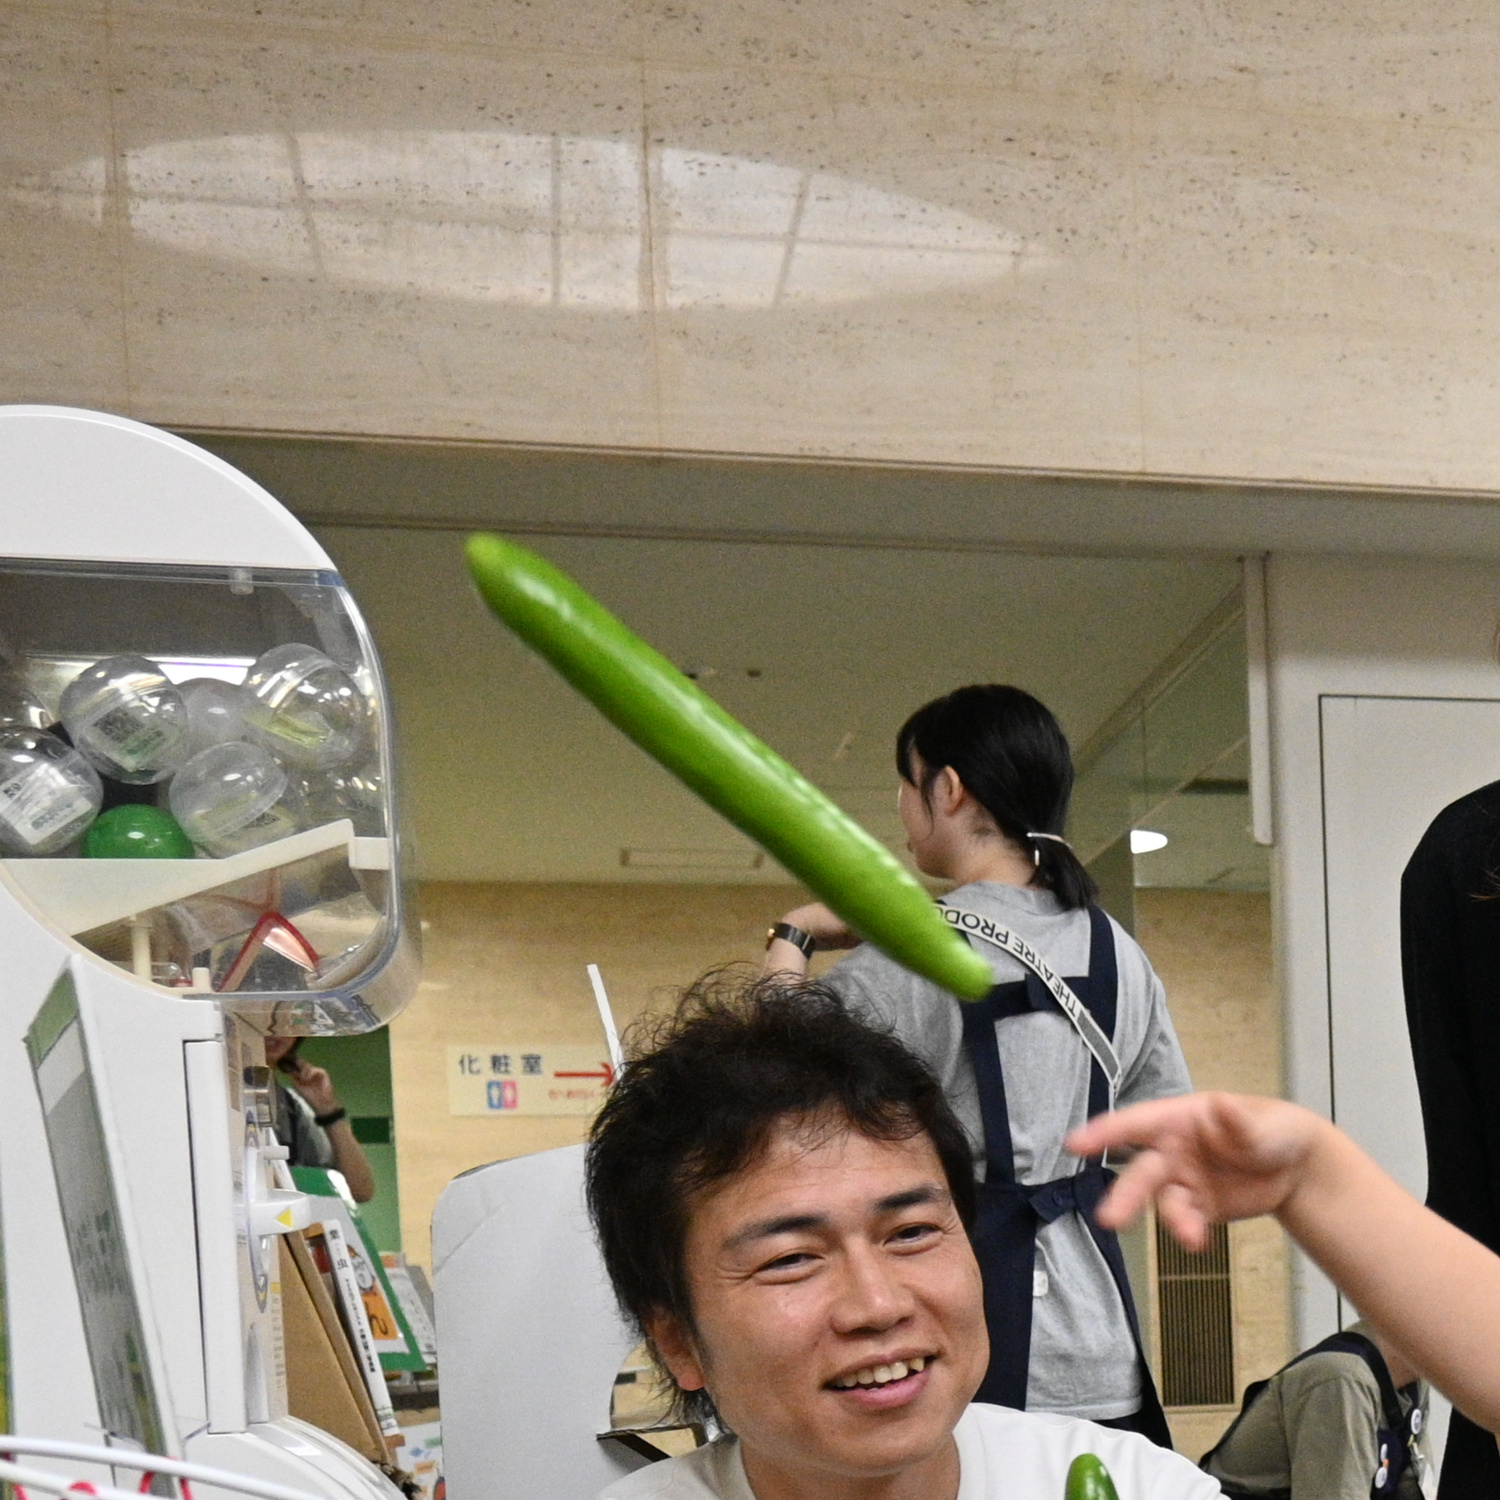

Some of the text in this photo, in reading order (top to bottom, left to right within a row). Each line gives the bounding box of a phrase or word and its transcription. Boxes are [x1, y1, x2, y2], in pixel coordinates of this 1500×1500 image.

[936, 907, 1077, 1018] THEATRE PROD
[458, 1054, 543, 1076] 化粧室
